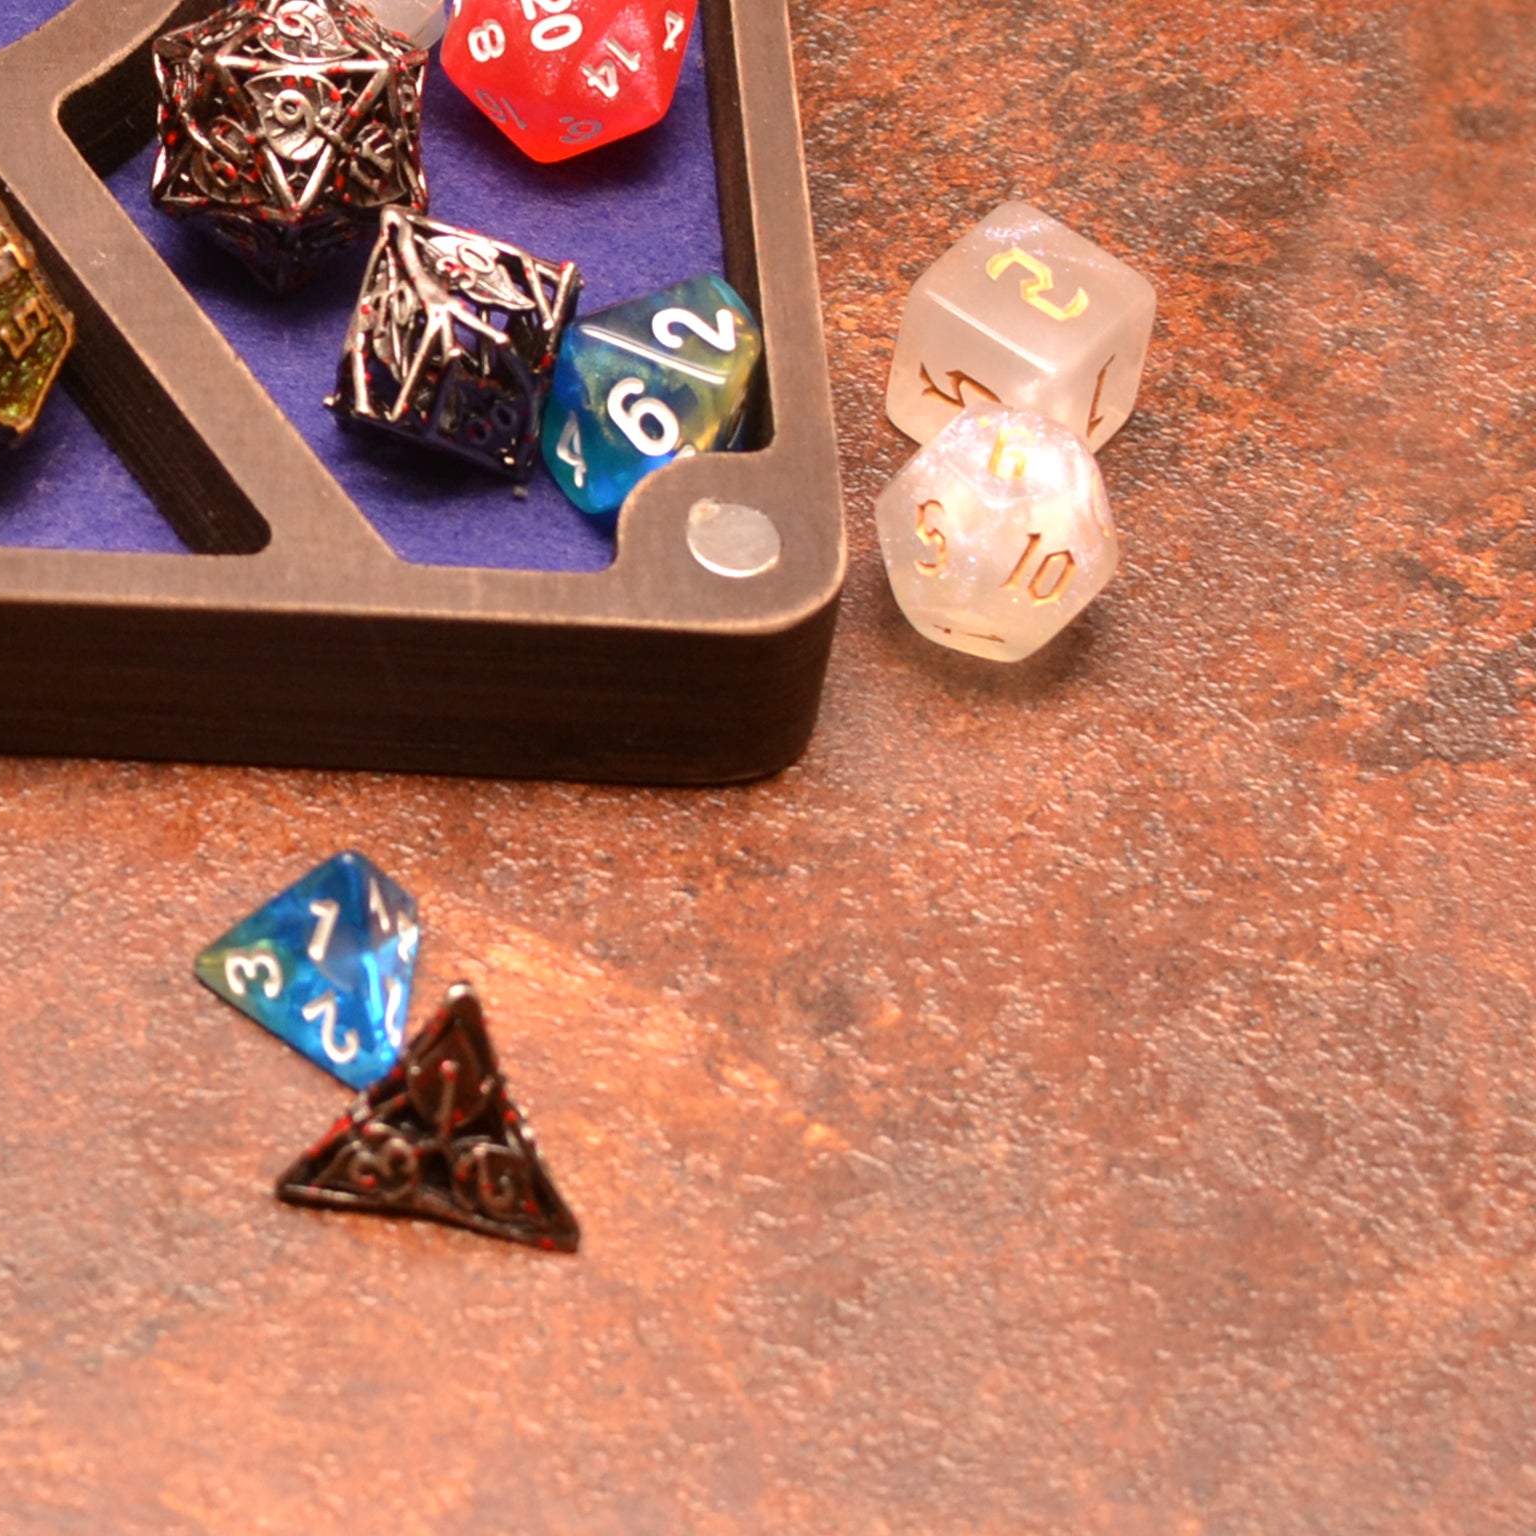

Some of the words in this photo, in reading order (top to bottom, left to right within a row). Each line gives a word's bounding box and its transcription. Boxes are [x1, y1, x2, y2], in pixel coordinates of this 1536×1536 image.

[466, 18, 507, 63] 8
[582, 35, 642, 99] 14
[651, 307, 736, 352] 2
[556, 410, 588, 488] 4
[998, 531, 1079, 605] 10
[306, 898, 340, 962] 1
[368, 877, 390, 934] 1
[224, 949, 284, 999] 3
[301, 992, 360, 1065] 2
